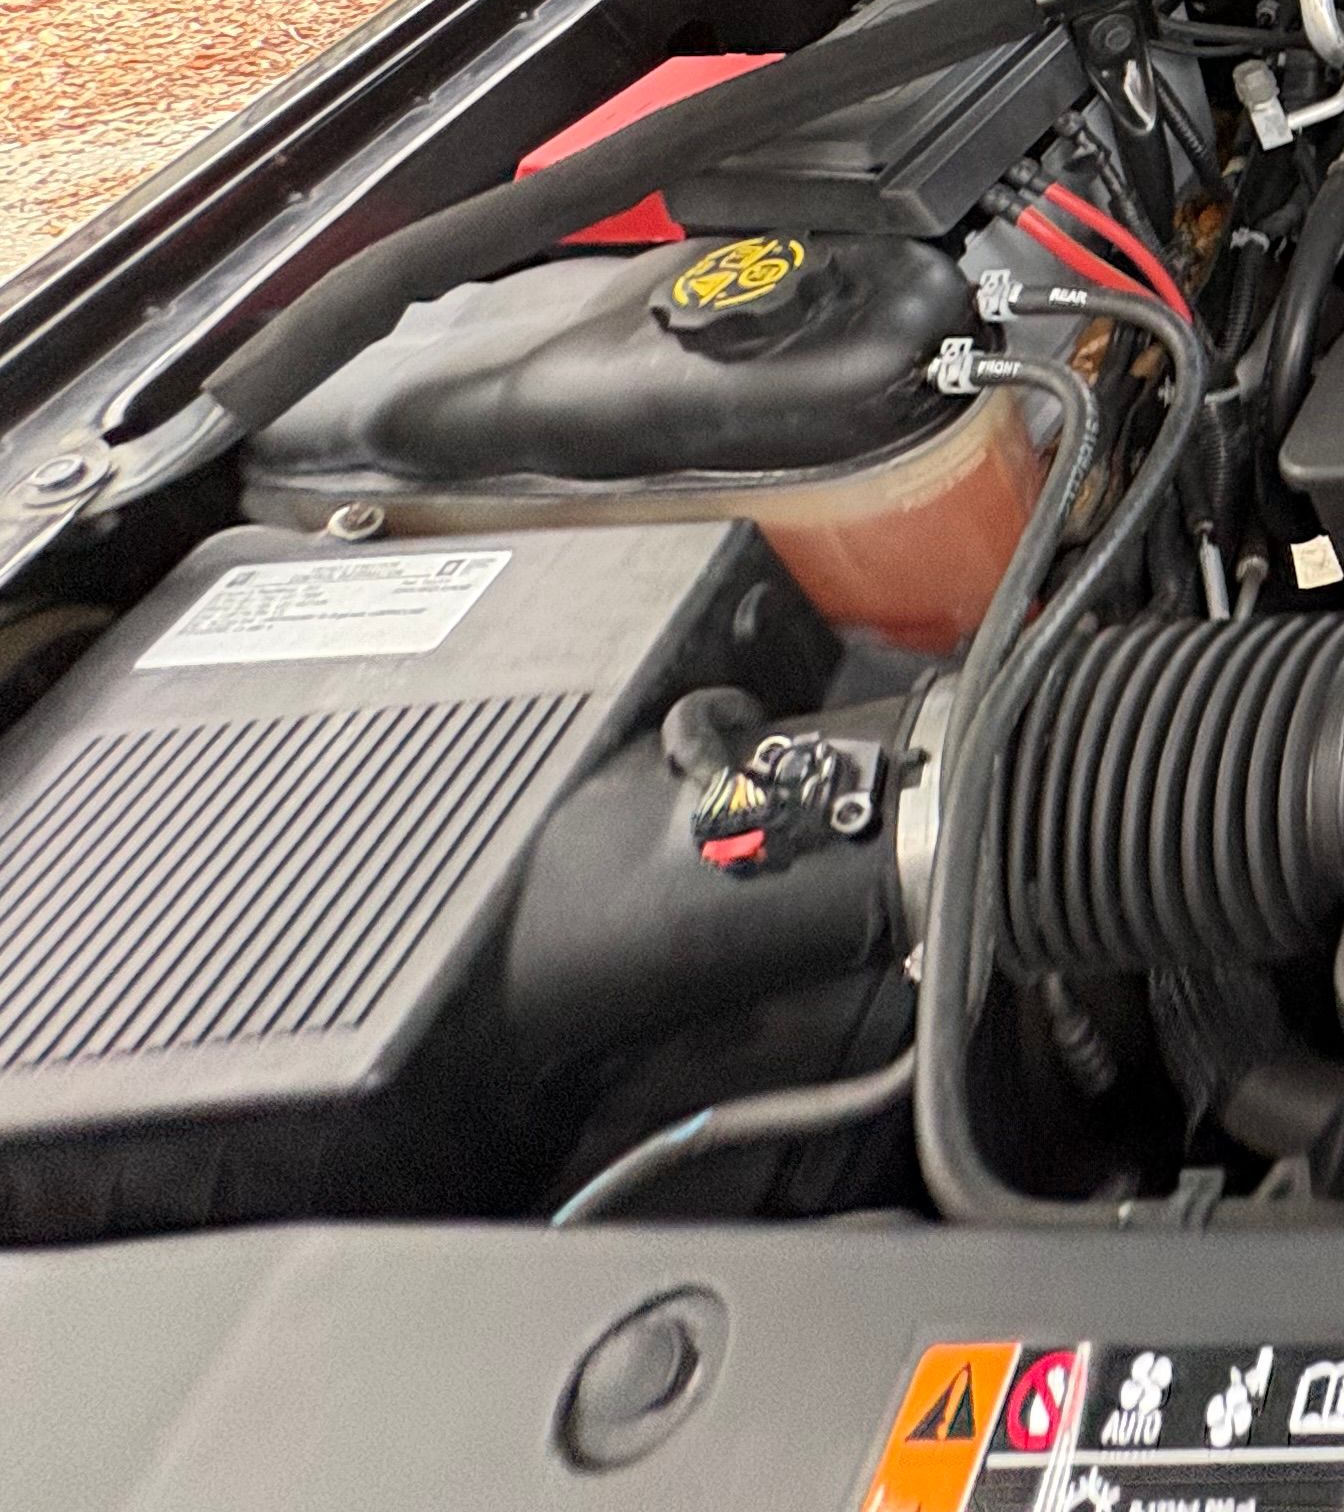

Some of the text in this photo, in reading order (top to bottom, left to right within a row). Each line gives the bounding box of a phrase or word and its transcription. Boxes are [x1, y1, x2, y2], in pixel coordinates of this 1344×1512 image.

[1049, 287, 1087, 306] REAR
[977, 360, 1023, 378] FRONT
[1101, 1409, 1162, 1446] AUTO
